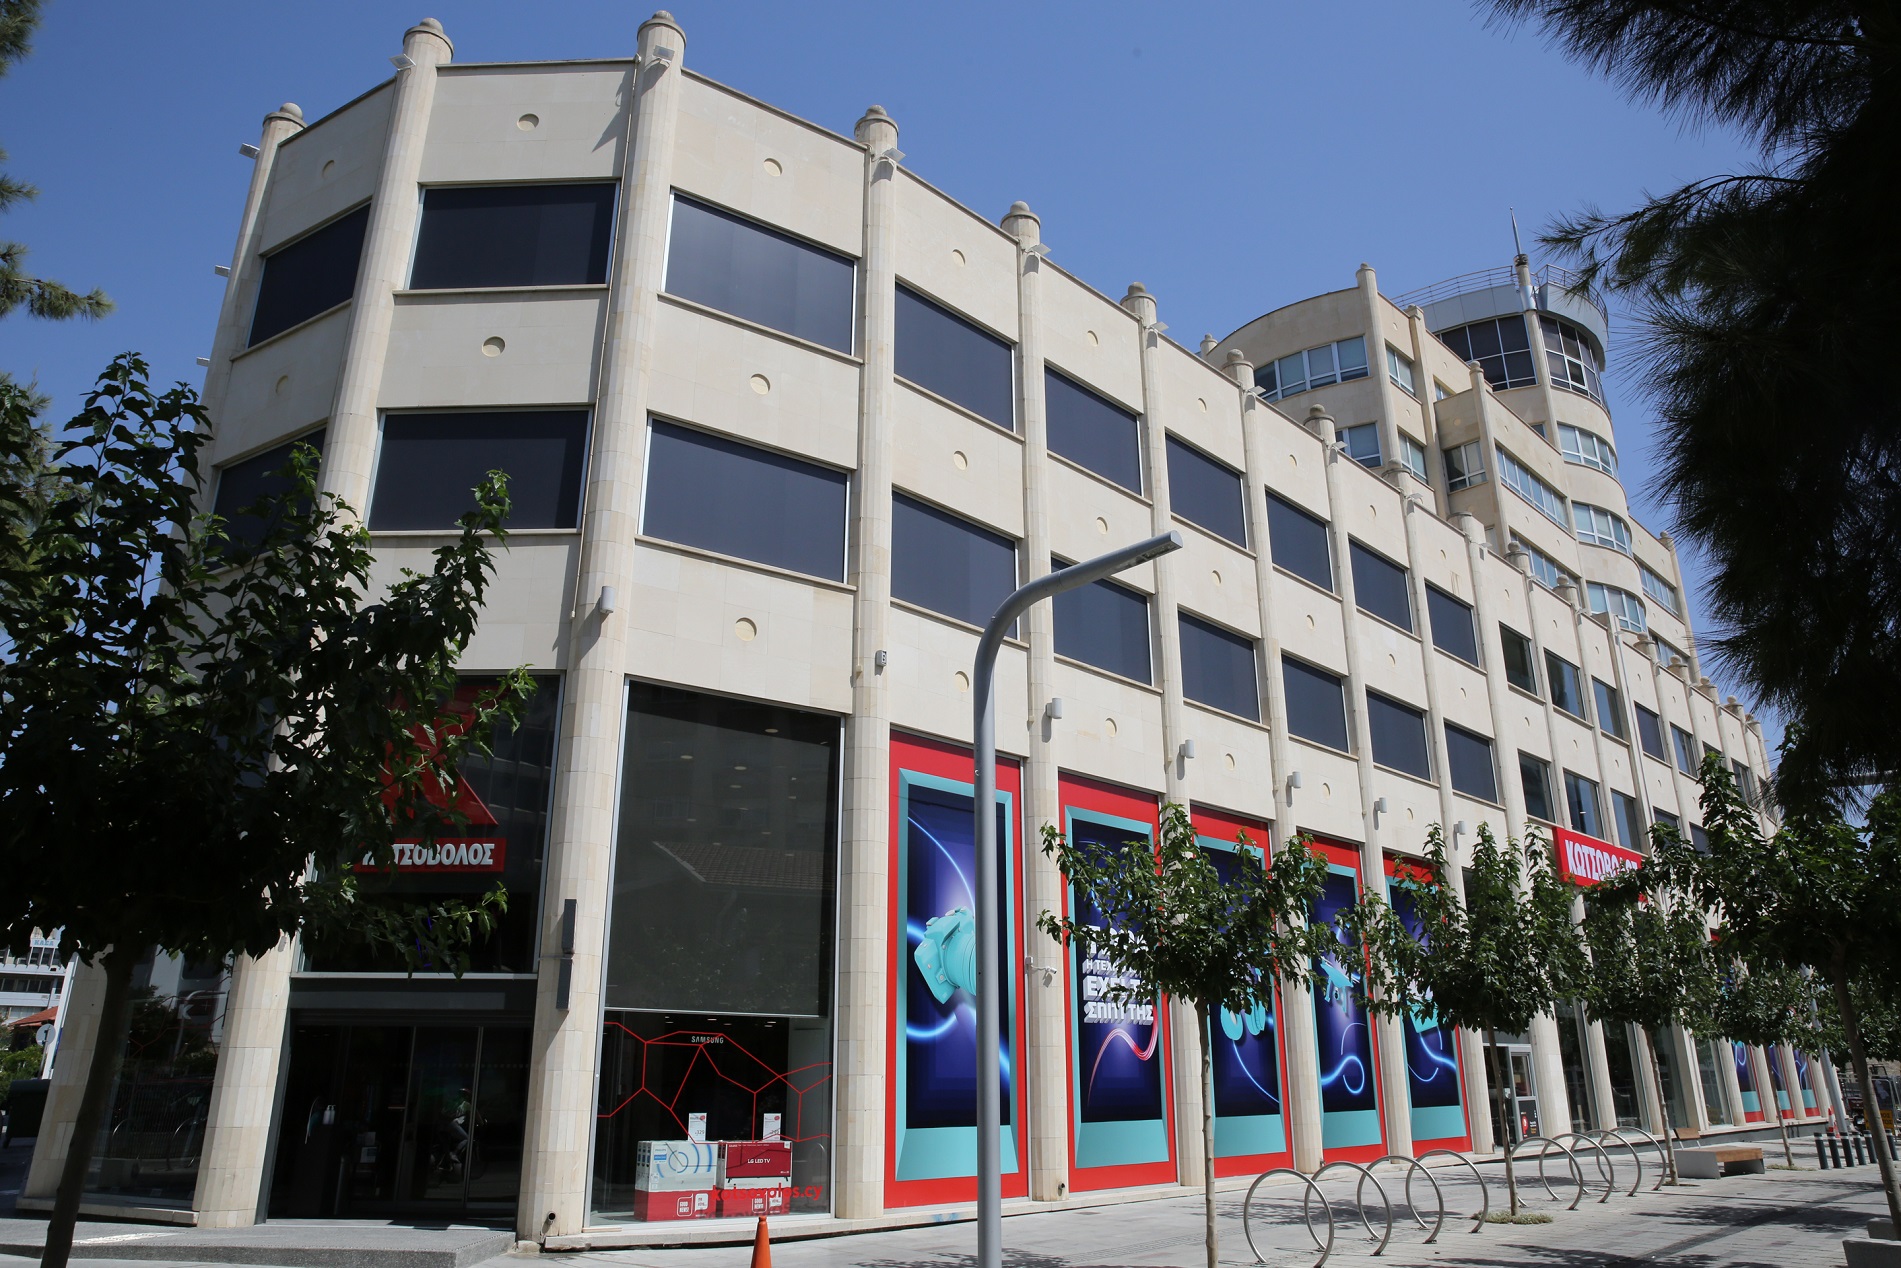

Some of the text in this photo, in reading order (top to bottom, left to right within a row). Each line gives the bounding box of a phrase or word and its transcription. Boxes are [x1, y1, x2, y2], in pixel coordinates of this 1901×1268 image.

[362, 844, 495, 865] ΚΤΣΟΒΟΛΟΣ
[1085, 1001, 1154, 1023] ΣΠΙΤΙ ΤΗΣ
[691, 1035, 724, 1044] SAMSUNG
